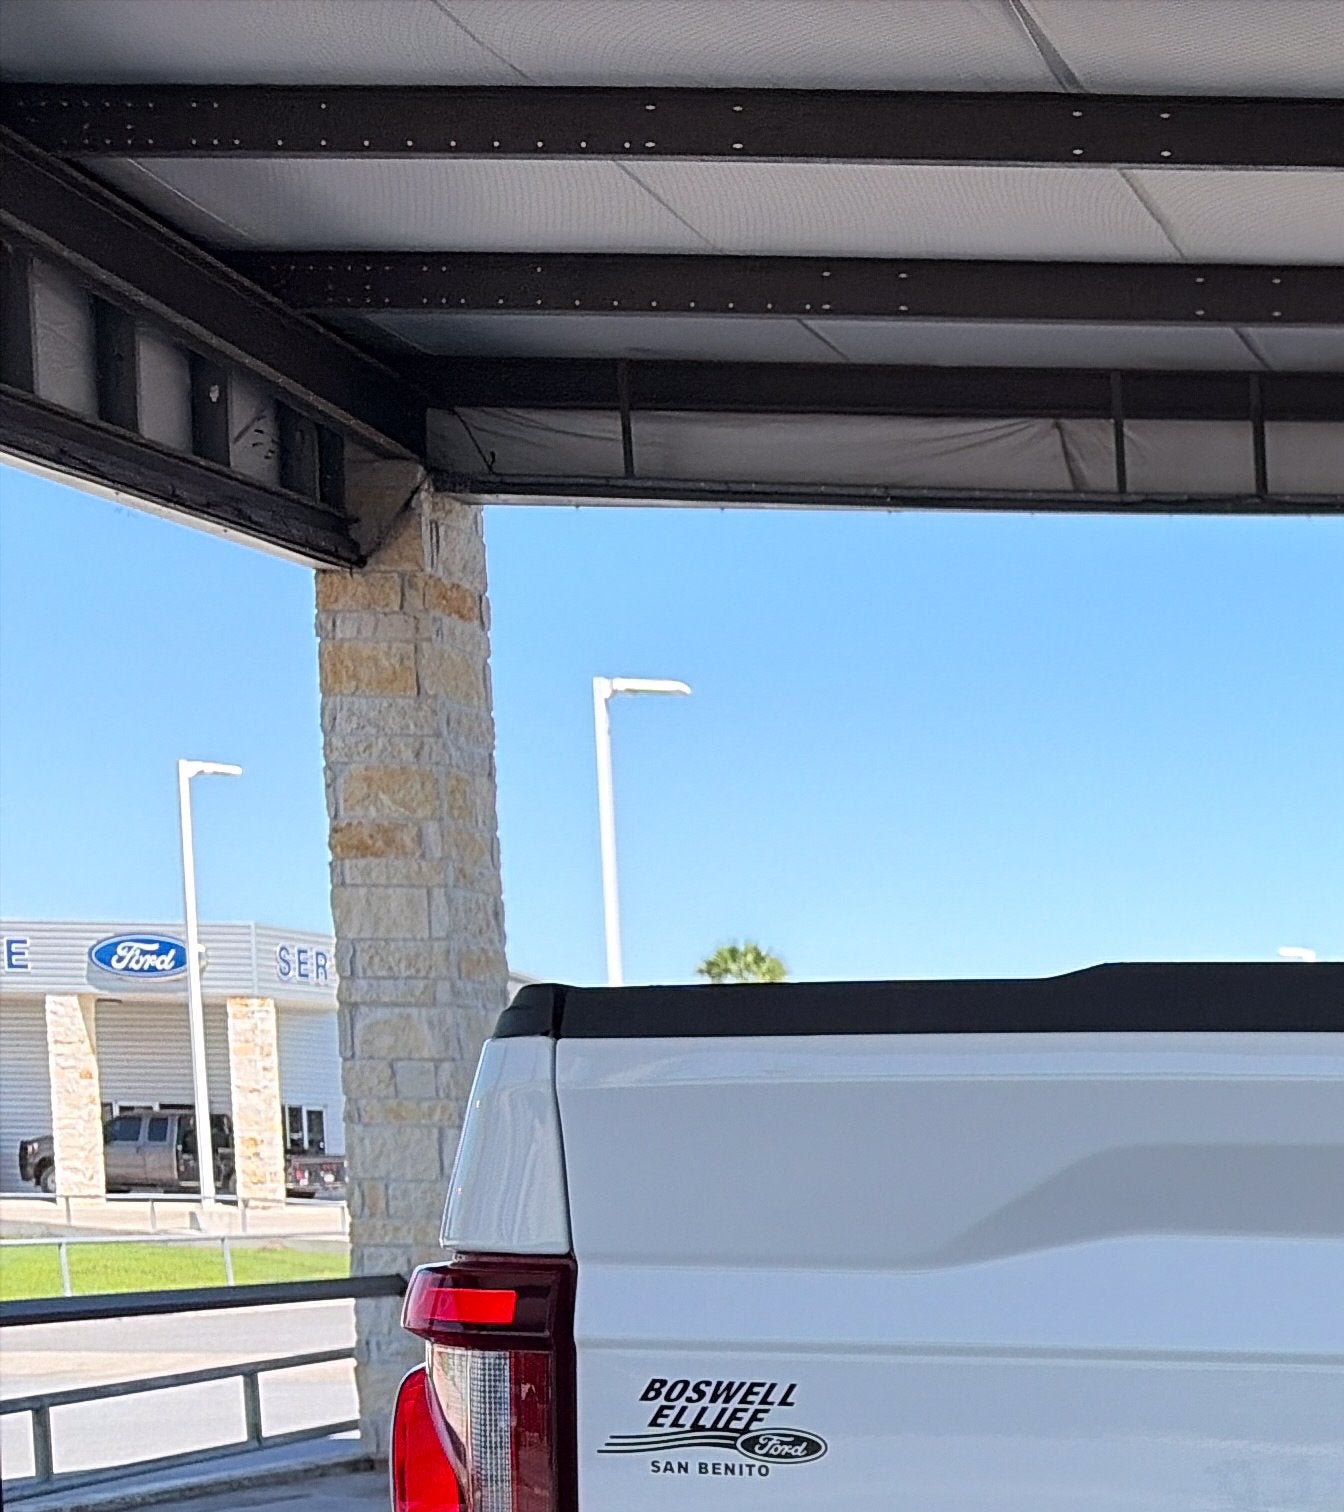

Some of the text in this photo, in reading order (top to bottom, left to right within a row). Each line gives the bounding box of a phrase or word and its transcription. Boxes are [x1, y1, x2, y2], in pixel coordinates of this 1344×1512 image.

[110, 942, 176, 971] Ford
[640, 1378, 798, 1406] BOSWELL
[648, 1405, 770, 1431] ELLIFF
[755, 1434, 808, 1456] Ford
[651, 1461, 770, 1477] SAN BENITO
